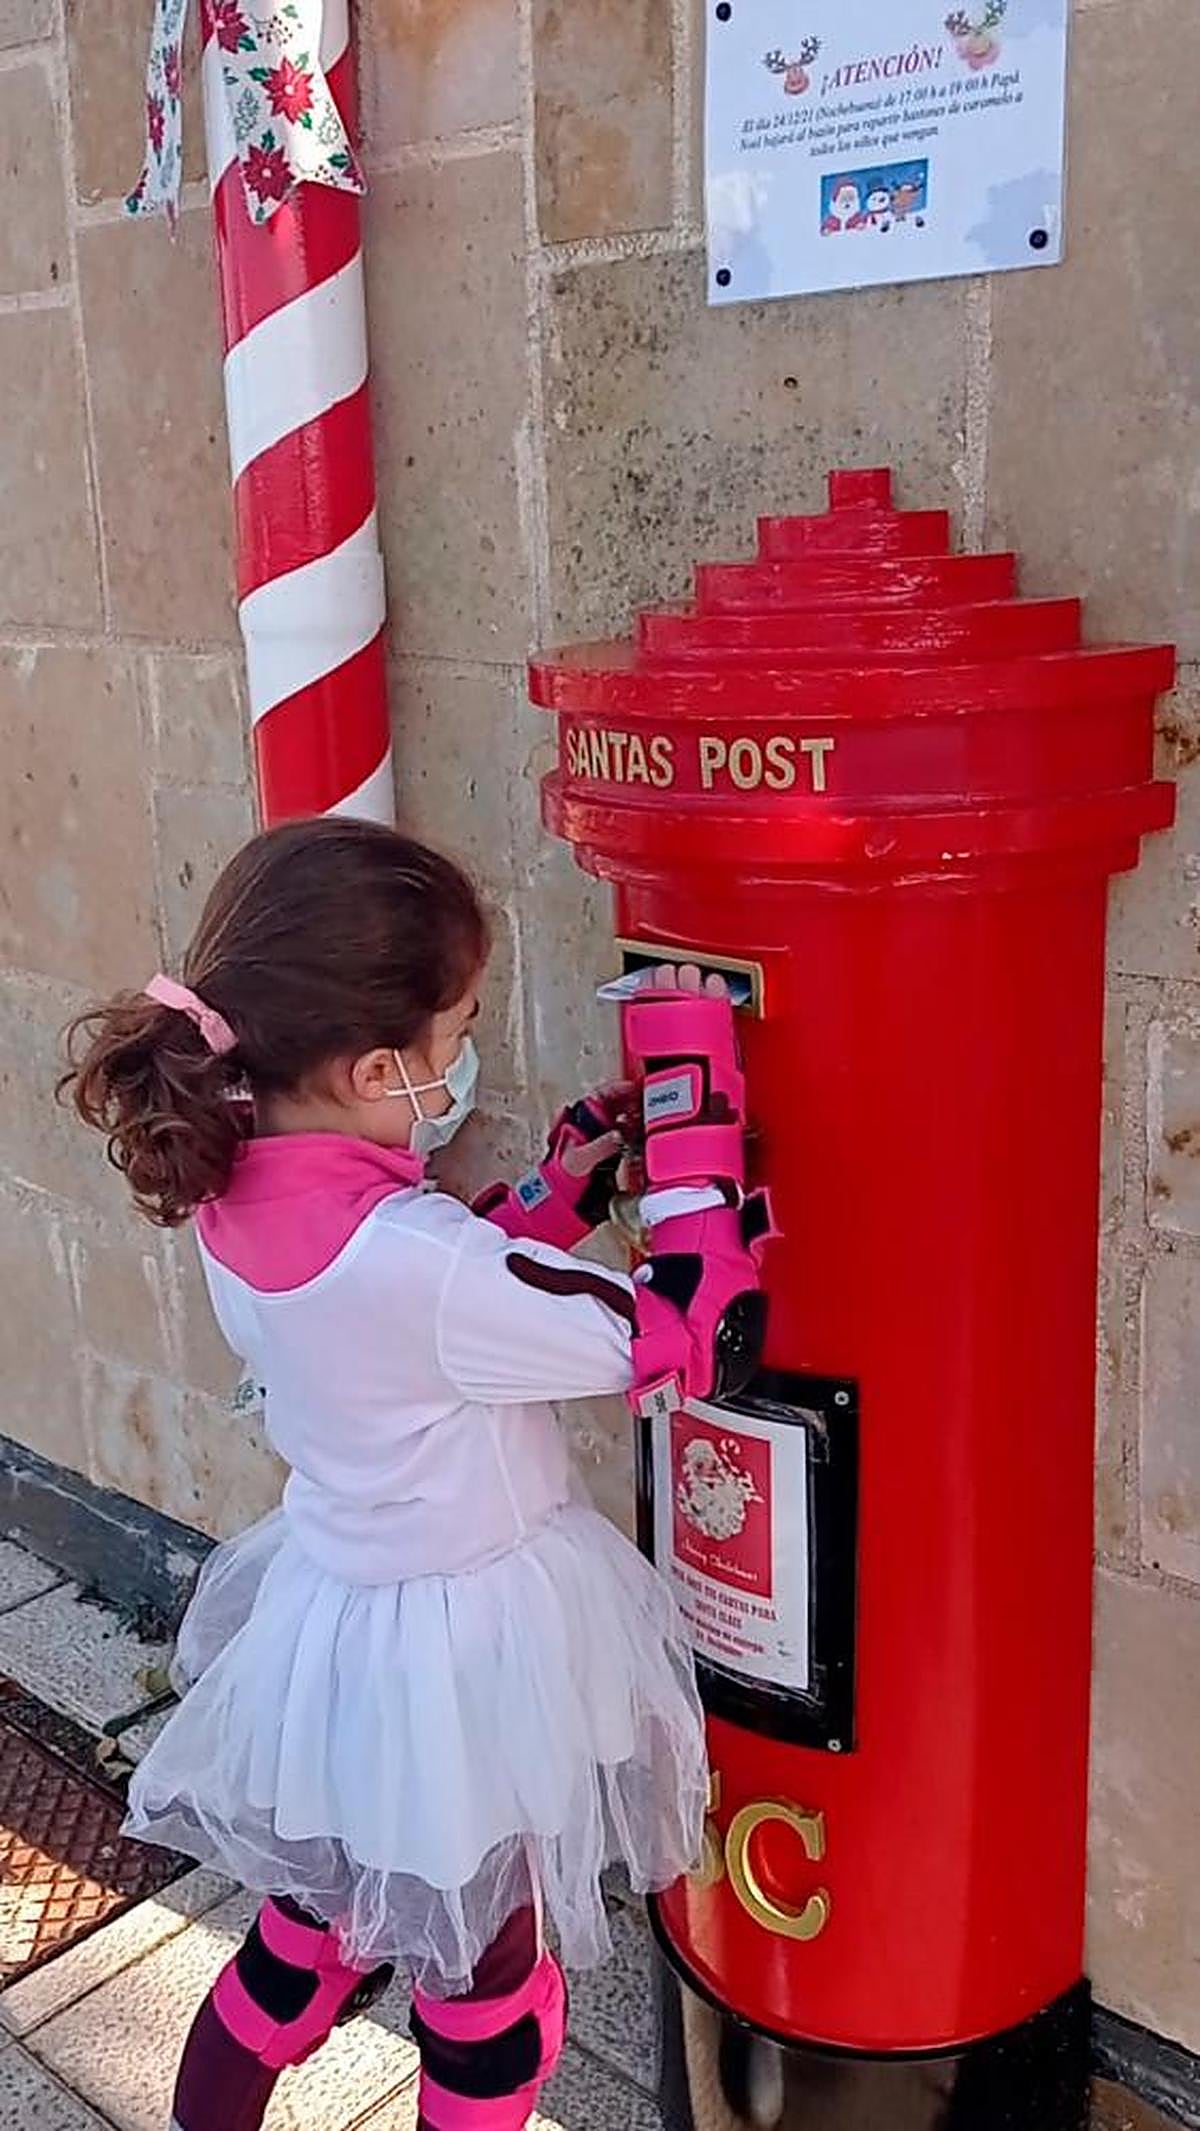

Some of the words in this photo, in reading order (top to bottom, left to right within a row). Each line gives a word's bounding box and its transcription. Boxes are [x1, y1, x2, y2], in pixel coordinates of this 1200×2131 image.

[820, 44, 943, 97] ¡ATENCIÓN!
[566, 728, 674, 788] SANTAS
[699, 736, 835, 793] POST
